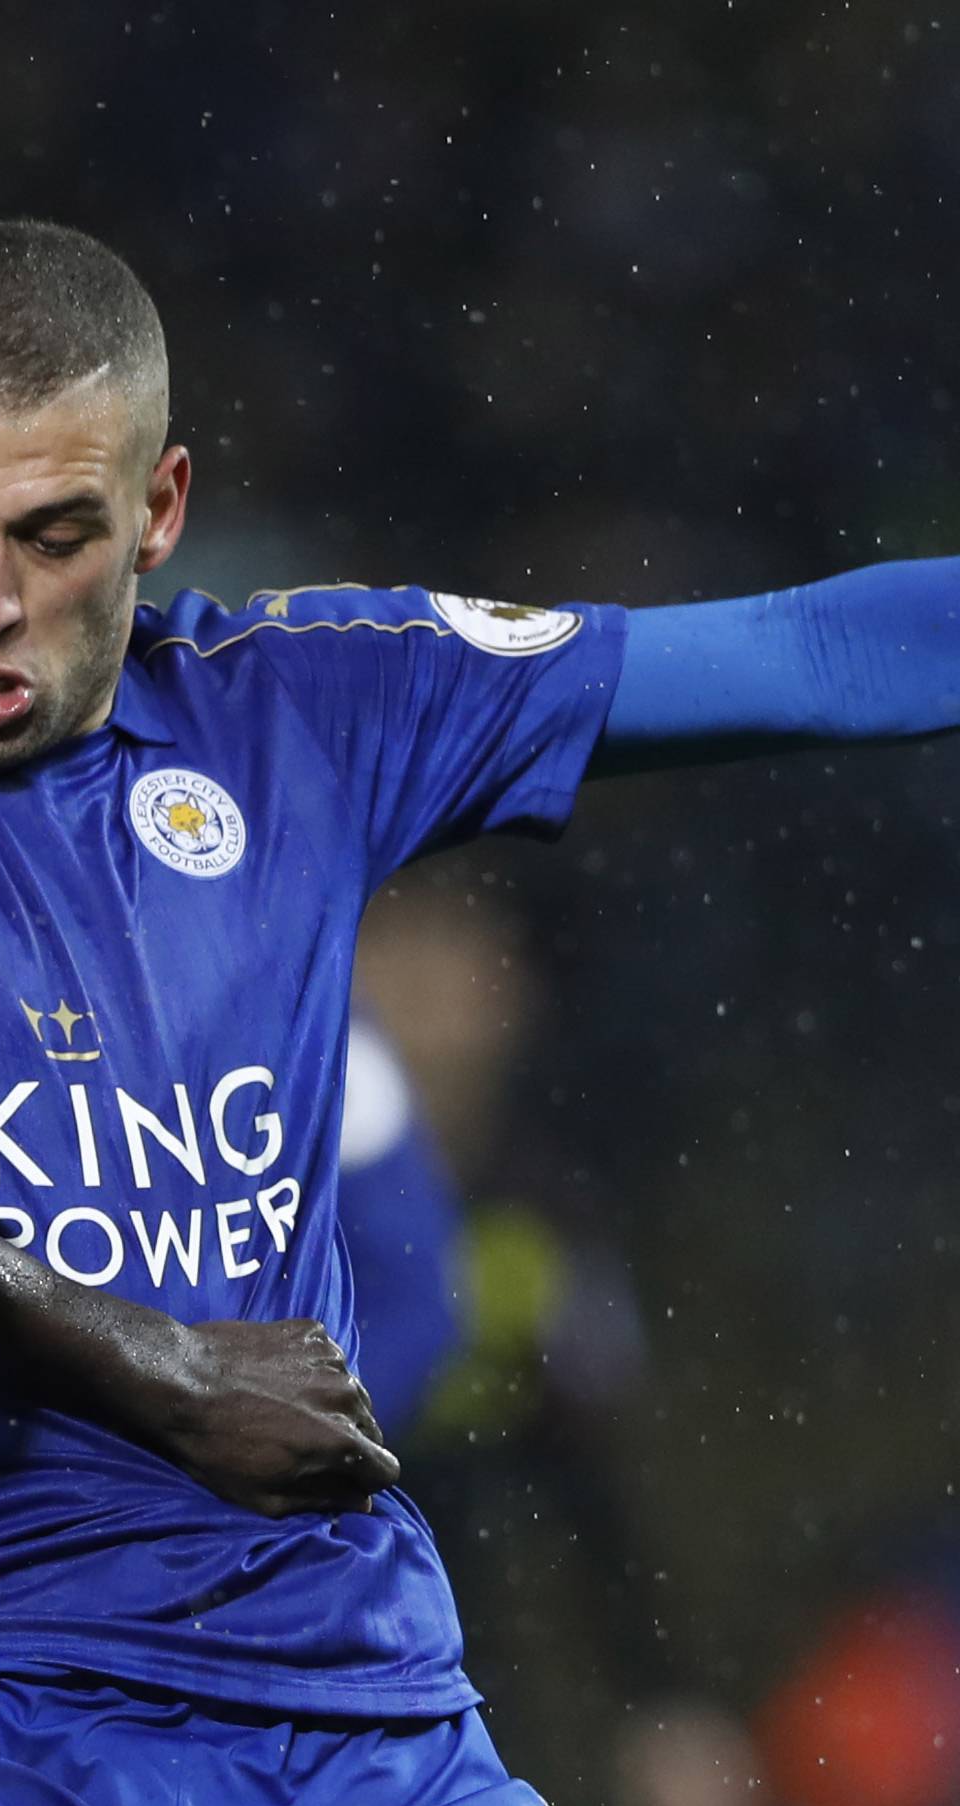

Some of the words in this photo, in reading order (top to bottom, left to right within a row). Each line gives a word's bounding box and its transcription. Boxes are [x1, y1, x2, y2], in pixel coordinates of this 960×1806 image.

[136, 775, 187, 829] LEICESTER
[191, 779, 229, 806] CITY
[148, 835, 230, 871] FOOTBALL
[224, 814, 240, 856] CLUB
